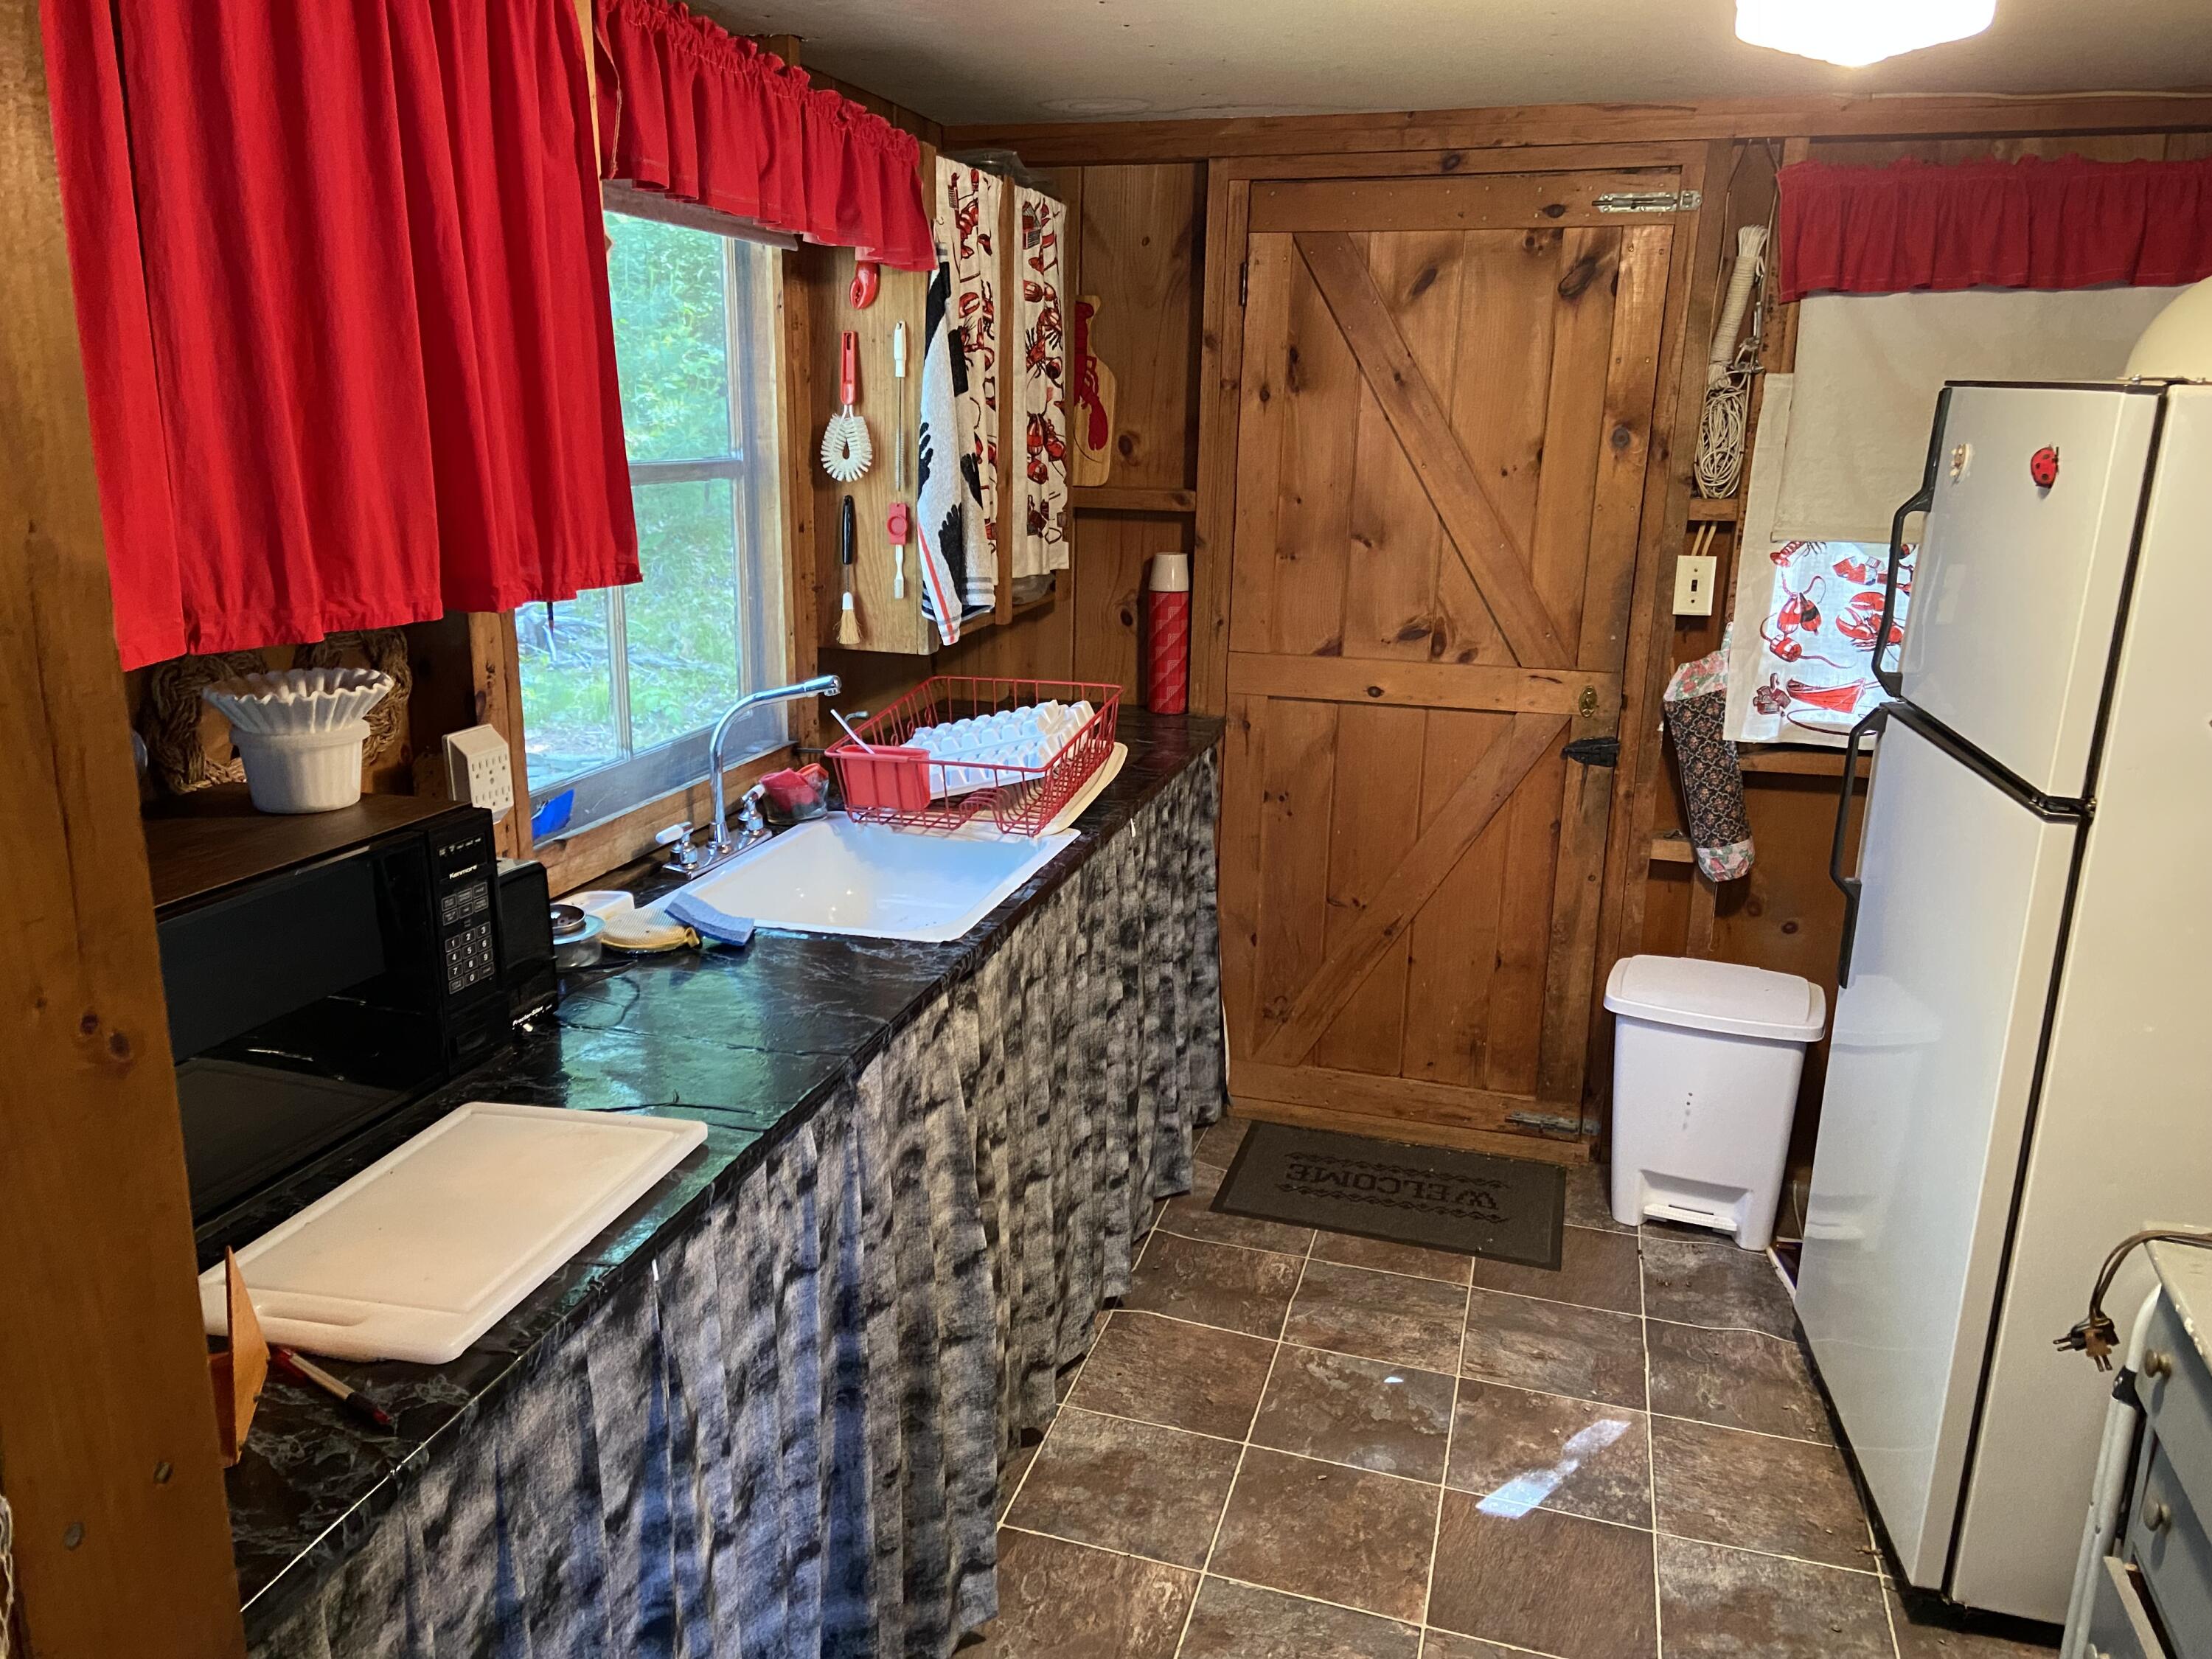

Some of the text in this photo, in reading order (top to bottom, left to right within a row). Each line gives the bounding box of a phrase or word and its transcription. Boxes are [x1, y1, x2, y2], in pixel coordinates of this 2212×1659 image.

[449, 863, 478, 880] Kenmore
[480, 926, 486, 934] 3
[481, 939, 487, 947] 6
[467, 946, 472, 954] 5
[483, 953, 488, 961] 9
[468, 960, 473, 968] 8
[453, 967, 458, 975] 7
[469, 973, 475, 981] 0
[1286, 1164, 1499, 1210] WELCOME
